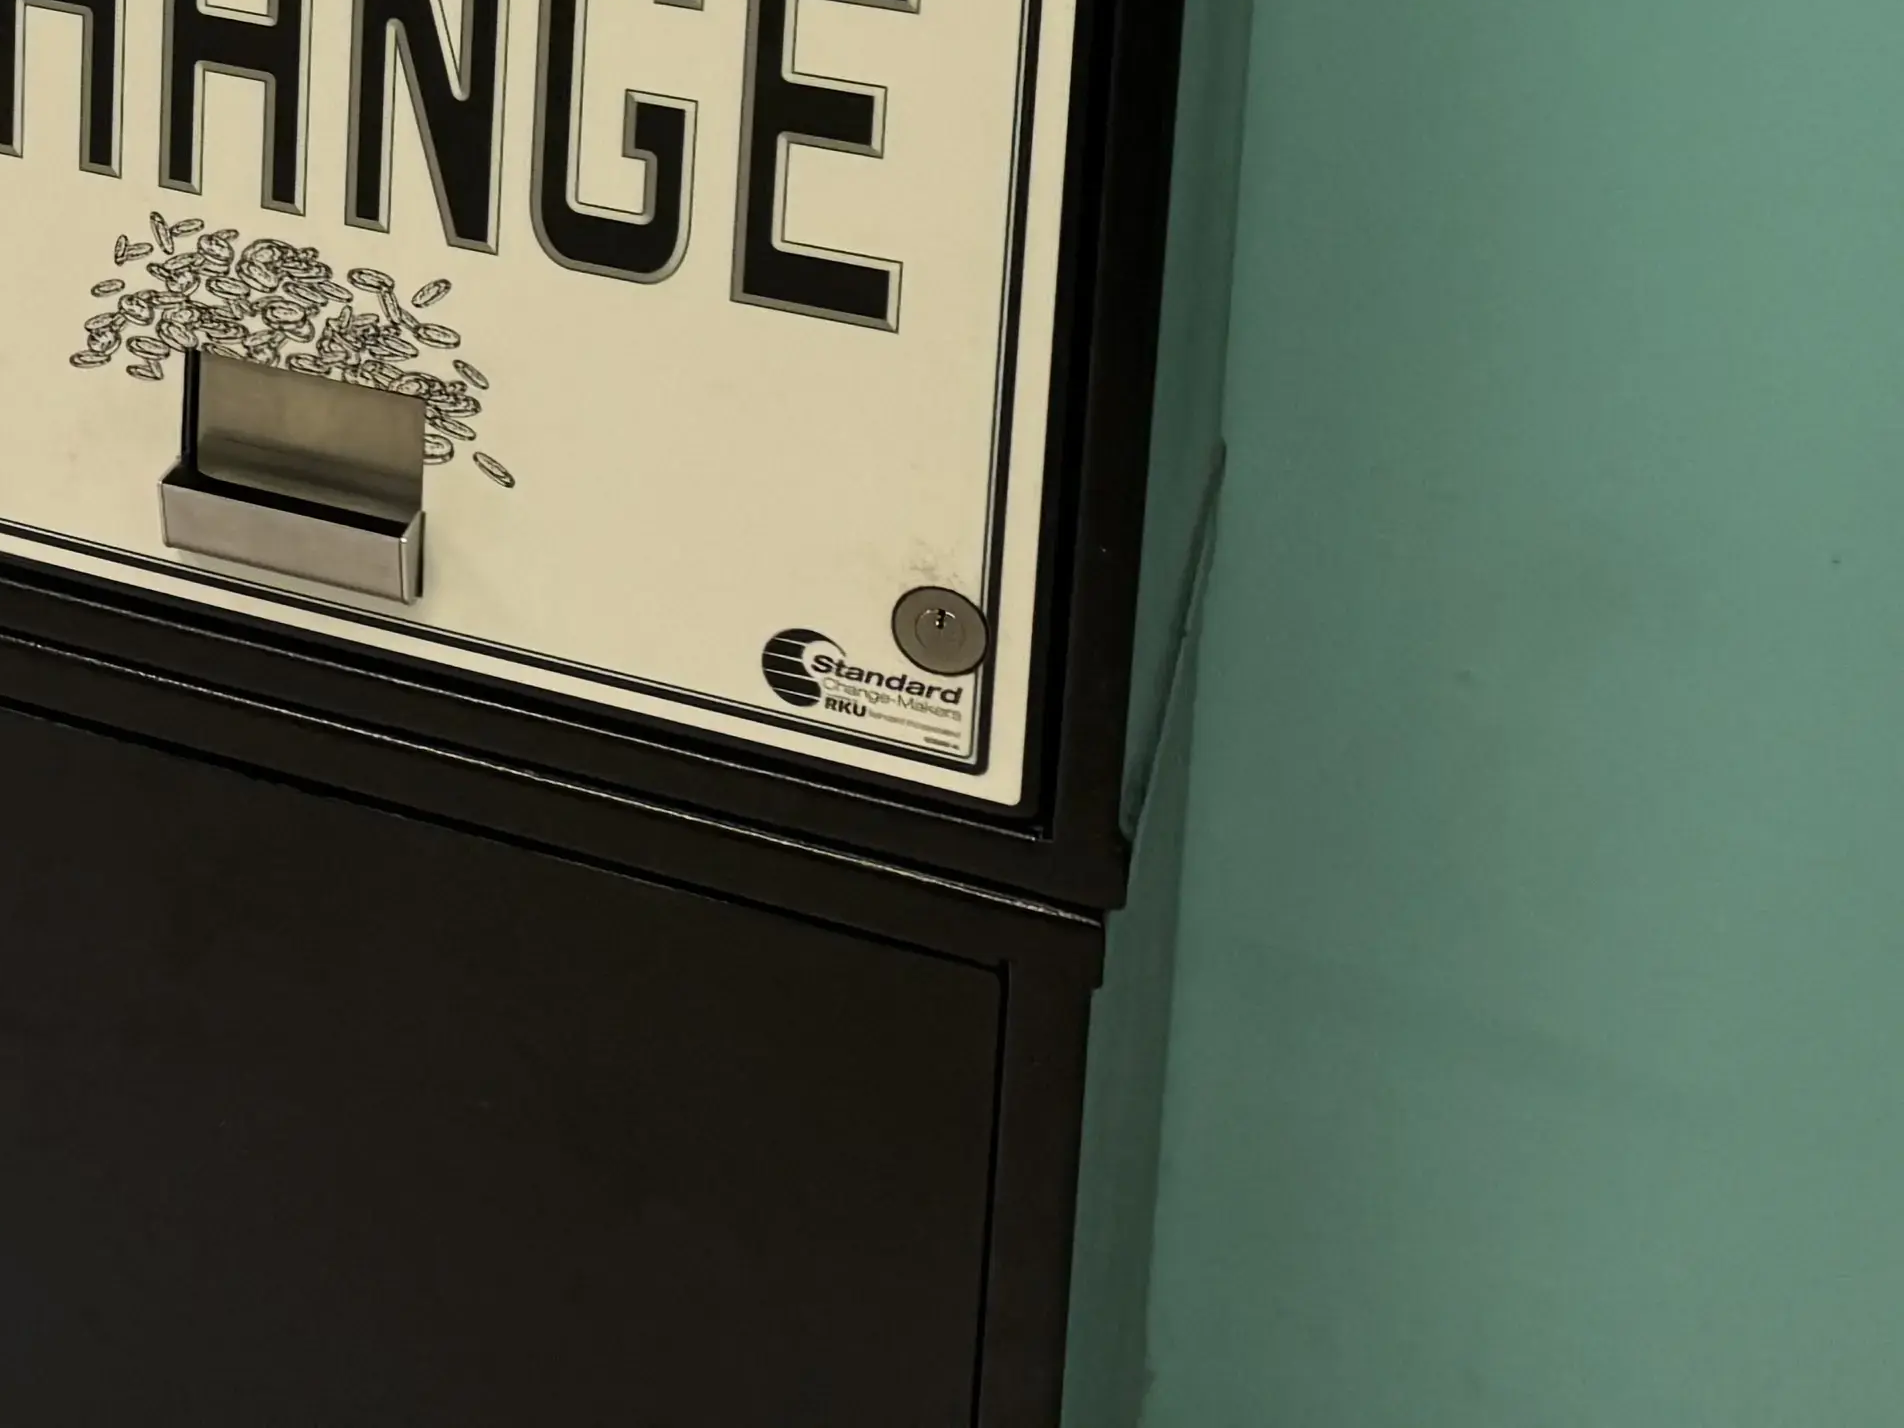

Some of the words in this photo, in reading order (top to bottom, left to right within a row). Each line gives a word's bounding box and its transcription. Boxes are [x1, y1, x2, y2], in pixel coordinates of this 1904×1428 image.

[810, 653, 964, 706] Standard
[822, 676, 962, 723] Change-Makers
[824, 695, 867, 718] RKU
